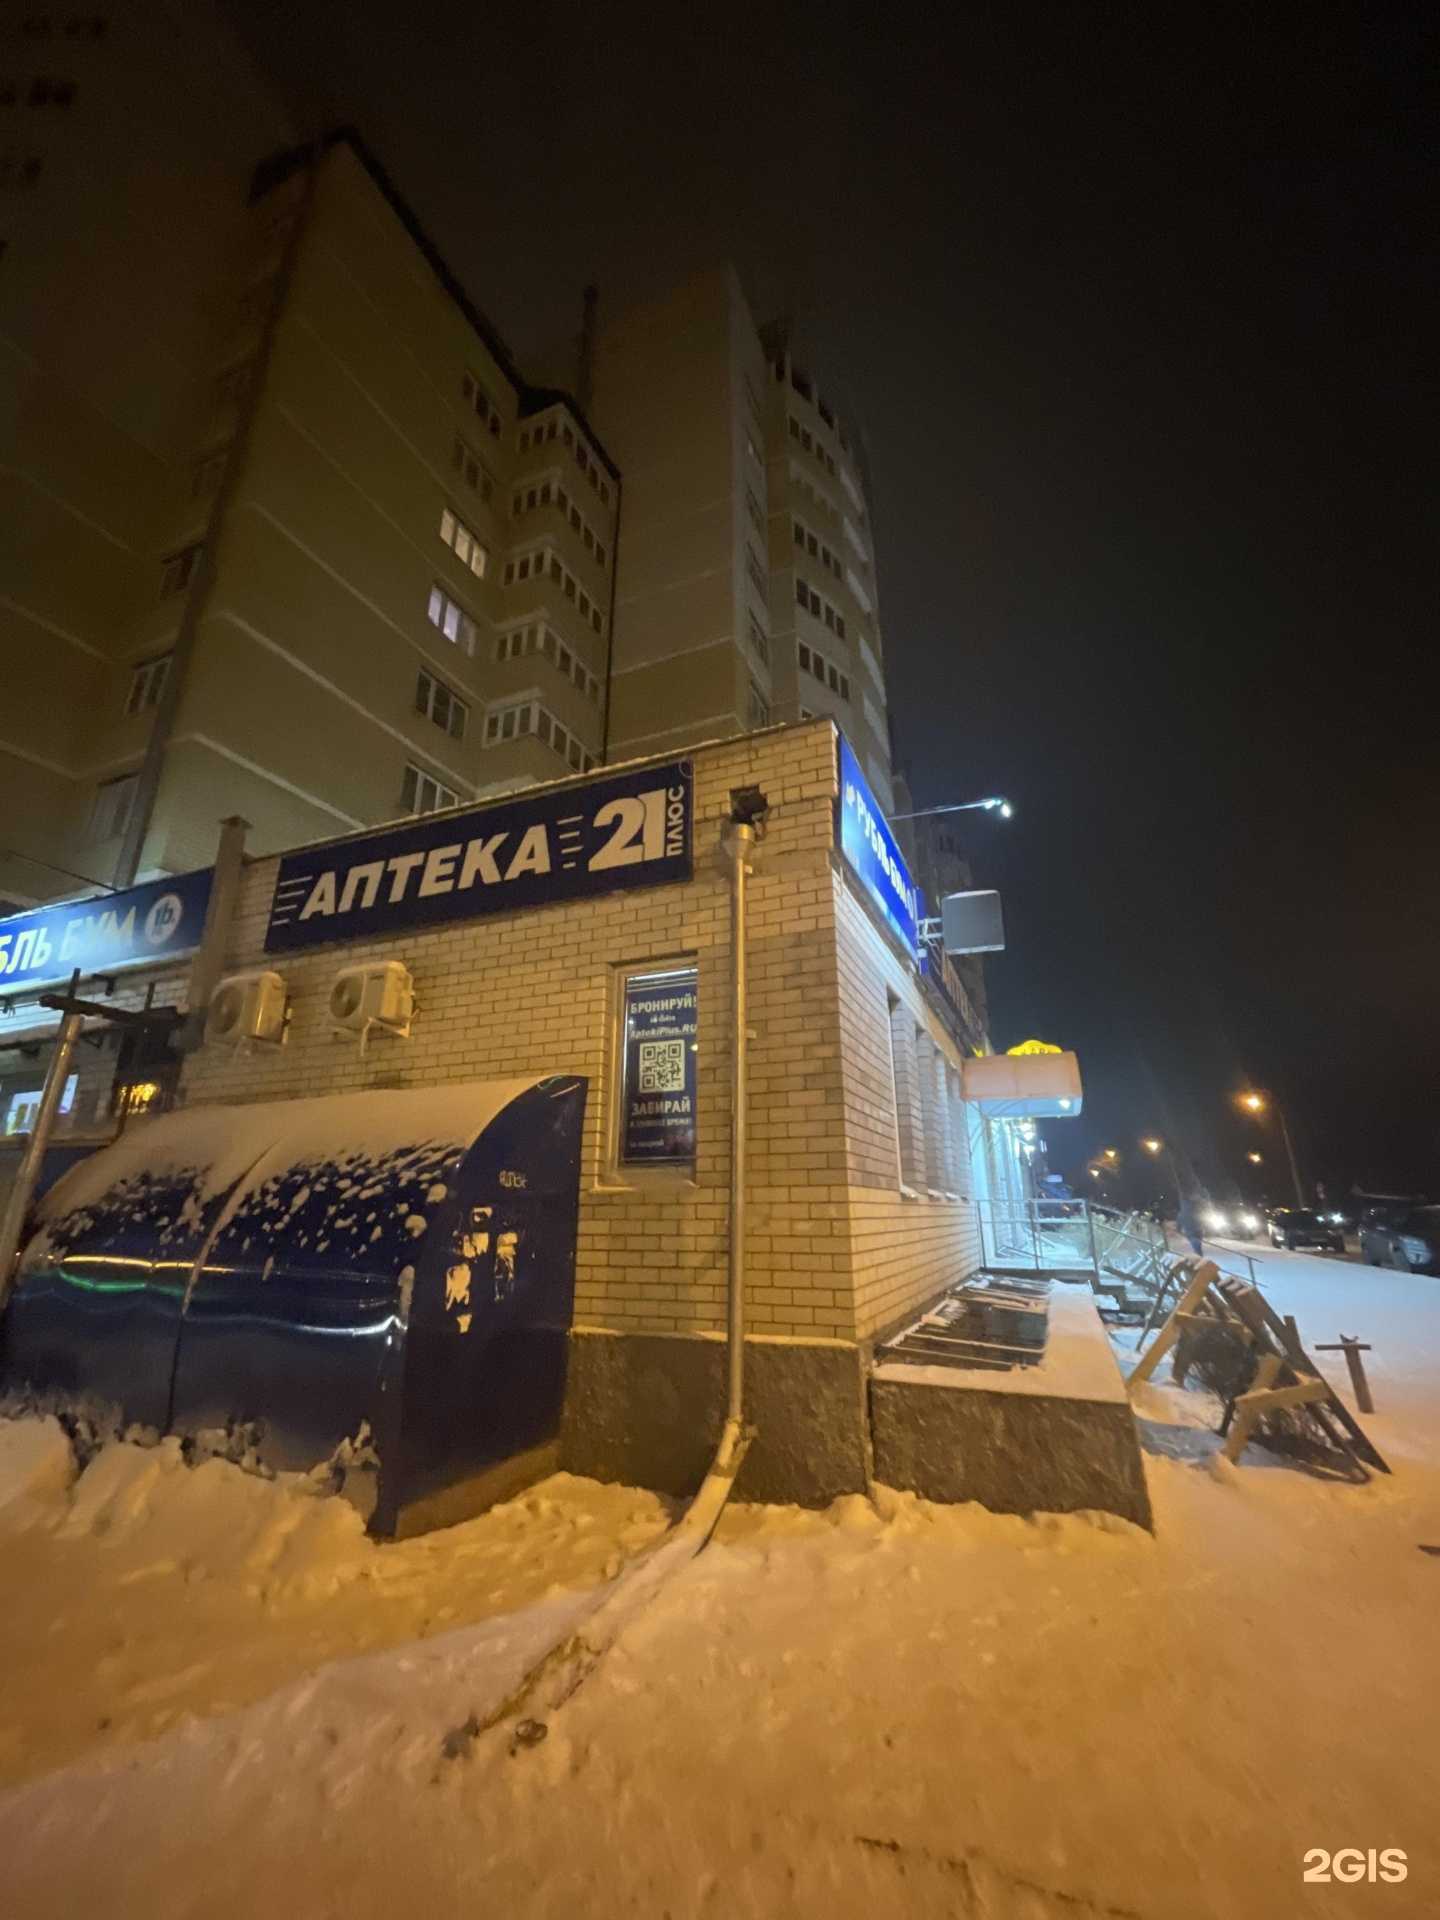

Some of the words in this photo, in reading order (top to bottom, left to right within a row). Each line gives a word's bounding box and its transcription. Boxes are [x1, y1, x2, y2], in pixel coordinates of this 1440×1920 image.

[298, 823, 551, 921] АПТЕКА
[587, 789, 667, 873] 21
[665, 784, 685, 857] ПЛЮС
